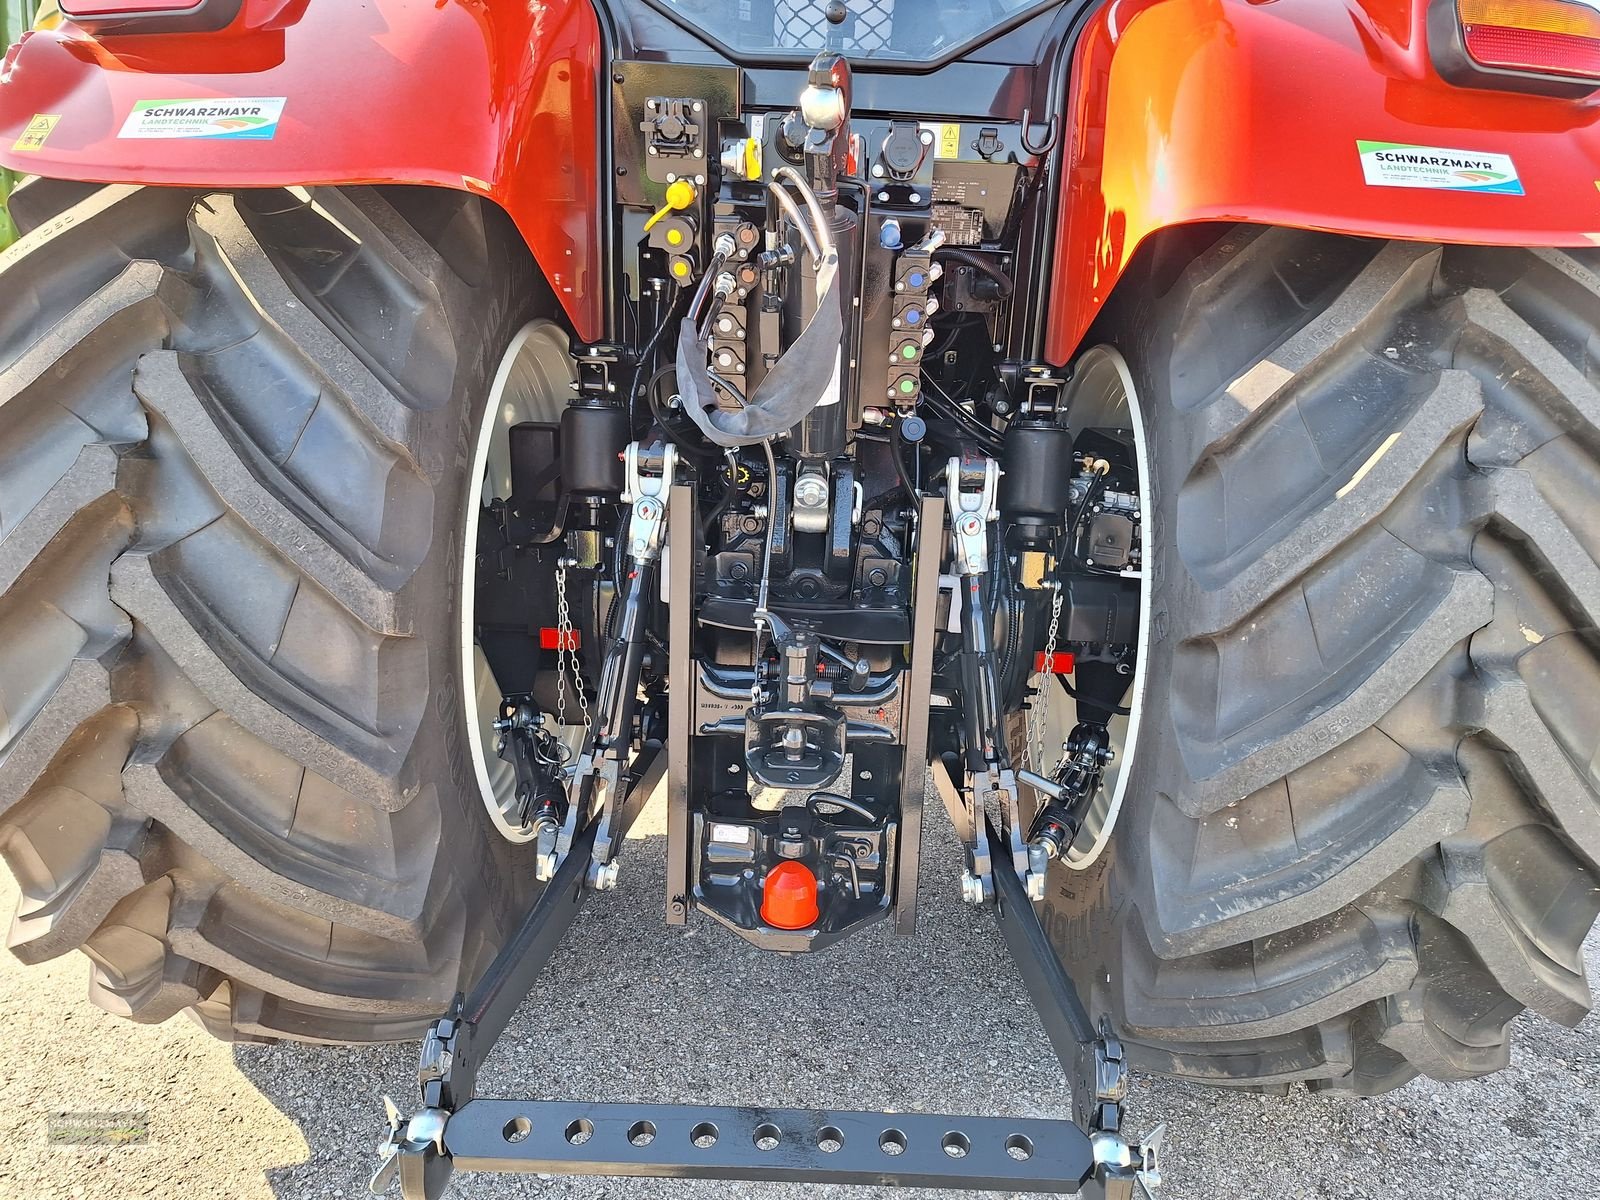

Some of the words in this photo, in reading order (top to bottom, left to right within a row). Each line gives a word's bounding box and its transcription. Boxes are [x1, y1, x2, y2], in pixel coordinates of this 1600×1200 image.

[143, 106, 261, 118] SCHWARZMAYR
[141, 118, 210, 126] LANDTECHNIK
[1375, 151, 1494, 171] SCHWARZMAYR
[1380, 163, 1451, 176] LANDTECHNIK
[1309, 314, 1344, 344] 1060
